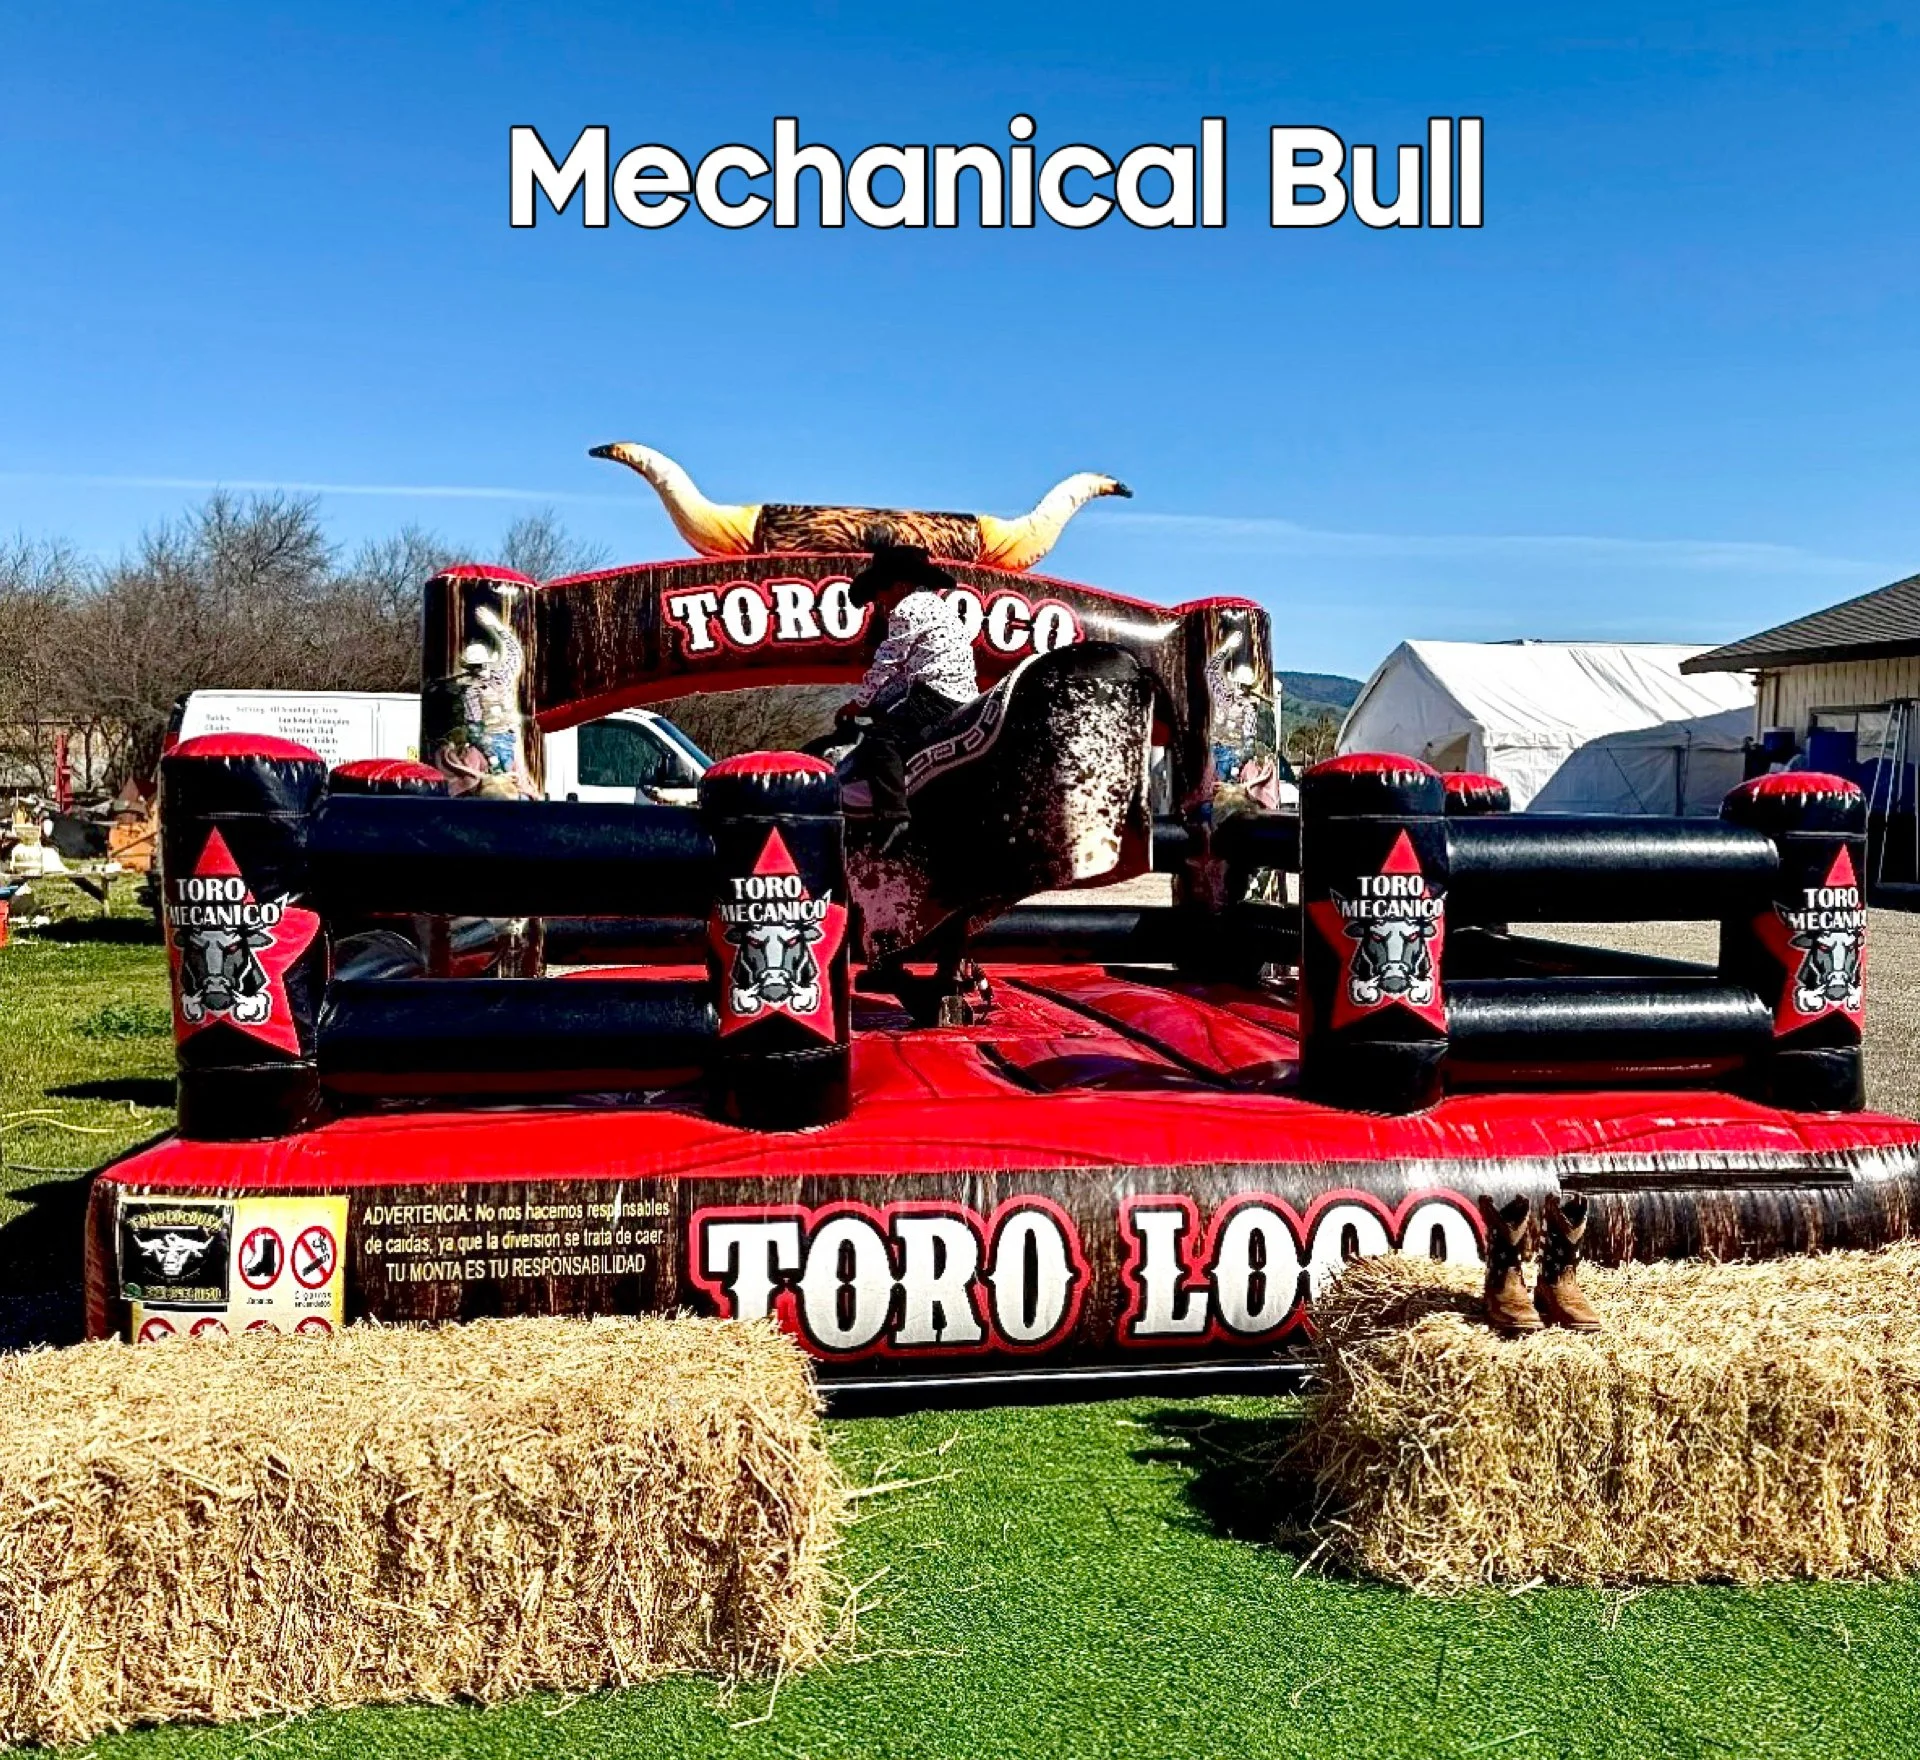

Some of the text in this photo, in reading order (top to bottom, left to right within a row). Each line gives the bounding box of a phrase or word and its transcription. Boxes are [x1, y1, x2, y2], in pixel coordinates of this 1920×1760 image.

[669, 580, 1076, 655] TORO OCO
[176, 877, 246, 901] TORO
[730, 875, 802, 900] TORO
[1356, 875, 1425, 897] TORO
[1802, 886, 1859, 909] TORO
[169, 902, 281, 926] MECANICO
[718, 898, 827, 922] MECANICO
[1339, 898, 1444, 919] MECANICO
[362, 1204, 472, 1226] ADVERTENCIA:
[474, 1202, 496, 1223] No
[497, 1206, 522, 1222] nos
[525, 1201, 583, 1220] hacemos
[364, 1235, 383, 1255] de
[437, 1235, 455, 1256] ya
[457, 1234, 483, 1256] que
[486, 1230, 499, 1250] la
[564, 1231, 580, 1247] se
[583, 1227, 613, 1247] trata
[615, 1225, 632, 1245] de
[635, 1227, 666, 1245] caer.
[385, 1253, 647, 1283] TU MONTA ES TU RESPONSABILIDAD
[704, 1208, 1077, 1350] TORO
[294, 1290, 332, 1301] Cgarros
